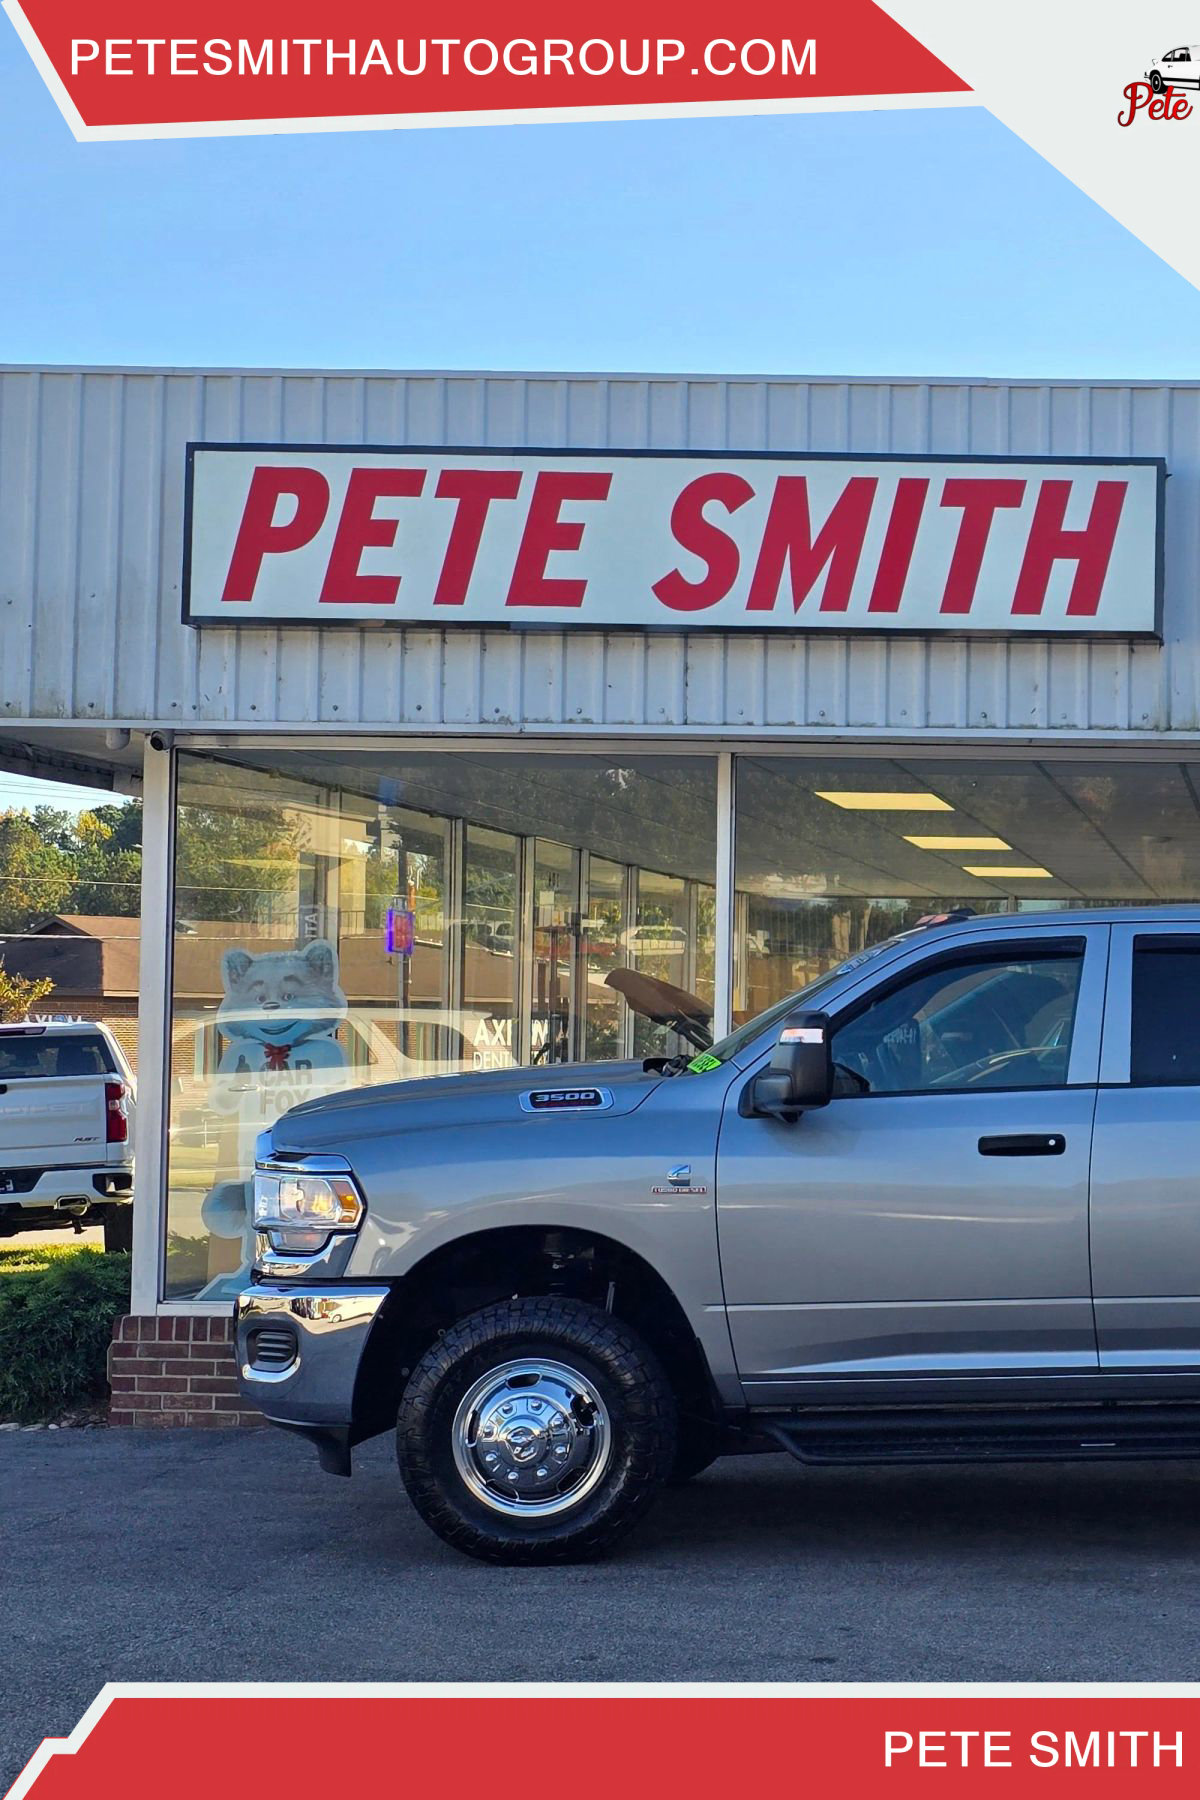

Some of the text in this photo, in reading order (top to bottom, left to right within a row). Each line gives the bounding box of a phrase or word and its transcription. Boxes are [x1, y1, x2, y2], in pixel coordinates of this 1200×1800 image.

[222, 467, 1129, 615] PETE SMITH
[535, 1092, 595, 1102] 3500
